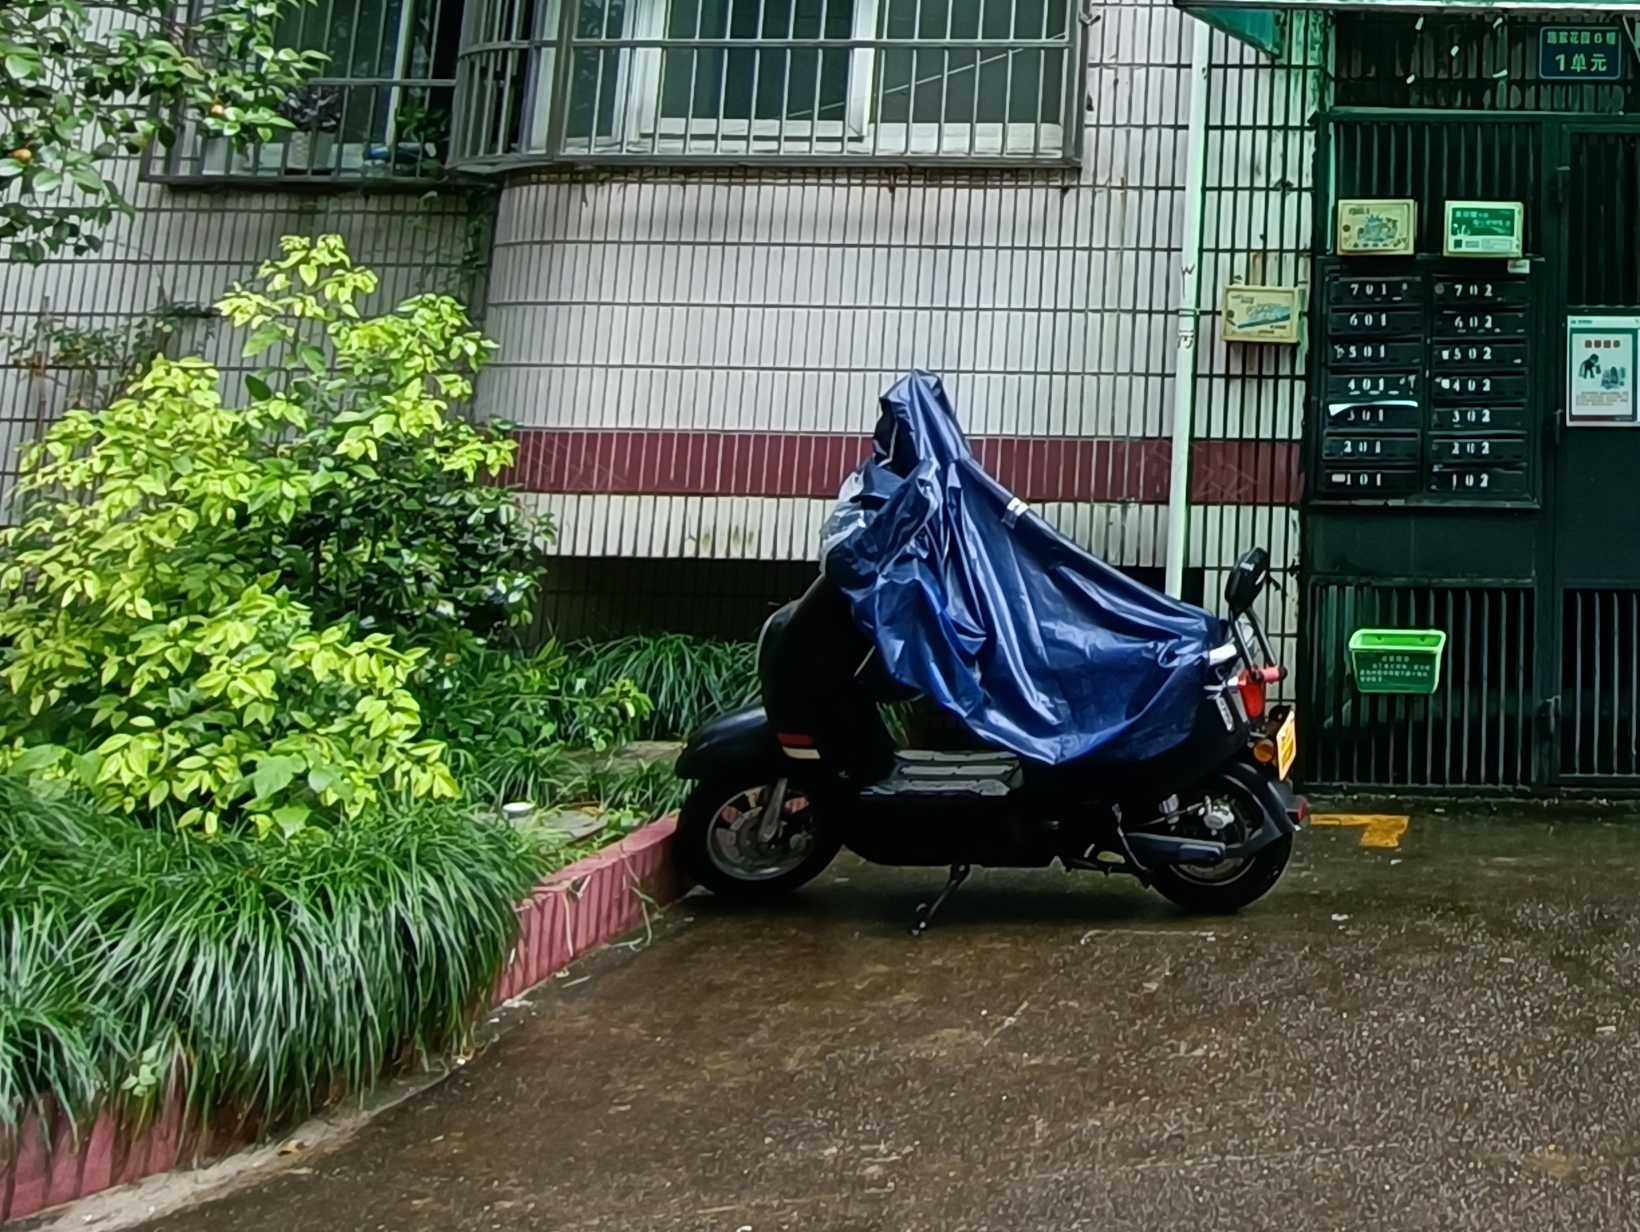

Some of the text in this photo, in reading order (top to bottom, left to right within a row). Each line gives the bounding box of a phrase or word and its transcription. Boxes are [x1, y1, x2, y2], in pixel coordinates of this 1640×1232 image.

[1555, 53, 1607, 72] 1单元
[1350, 283, 1387, 296] 701
[1454, 283, 1493, 297] 702
[1349, 313, 1387, 327] 601
[1454, 314, 1493, 328] 602
[1348, 345, 1385, 359] 501
[1453, 346, 1492, 360] 502
[1347, 377, 1385, 392] 401
[1453, 378, 1491, 392] 402
[1452, 409, 1491, 423] 302
[1343, 440, 1381, 454] 201
[1451, 441, 1490, 455] 202
[1346, 473, 1381, 487] 101
[1452, 473, 1489, 491] 102
